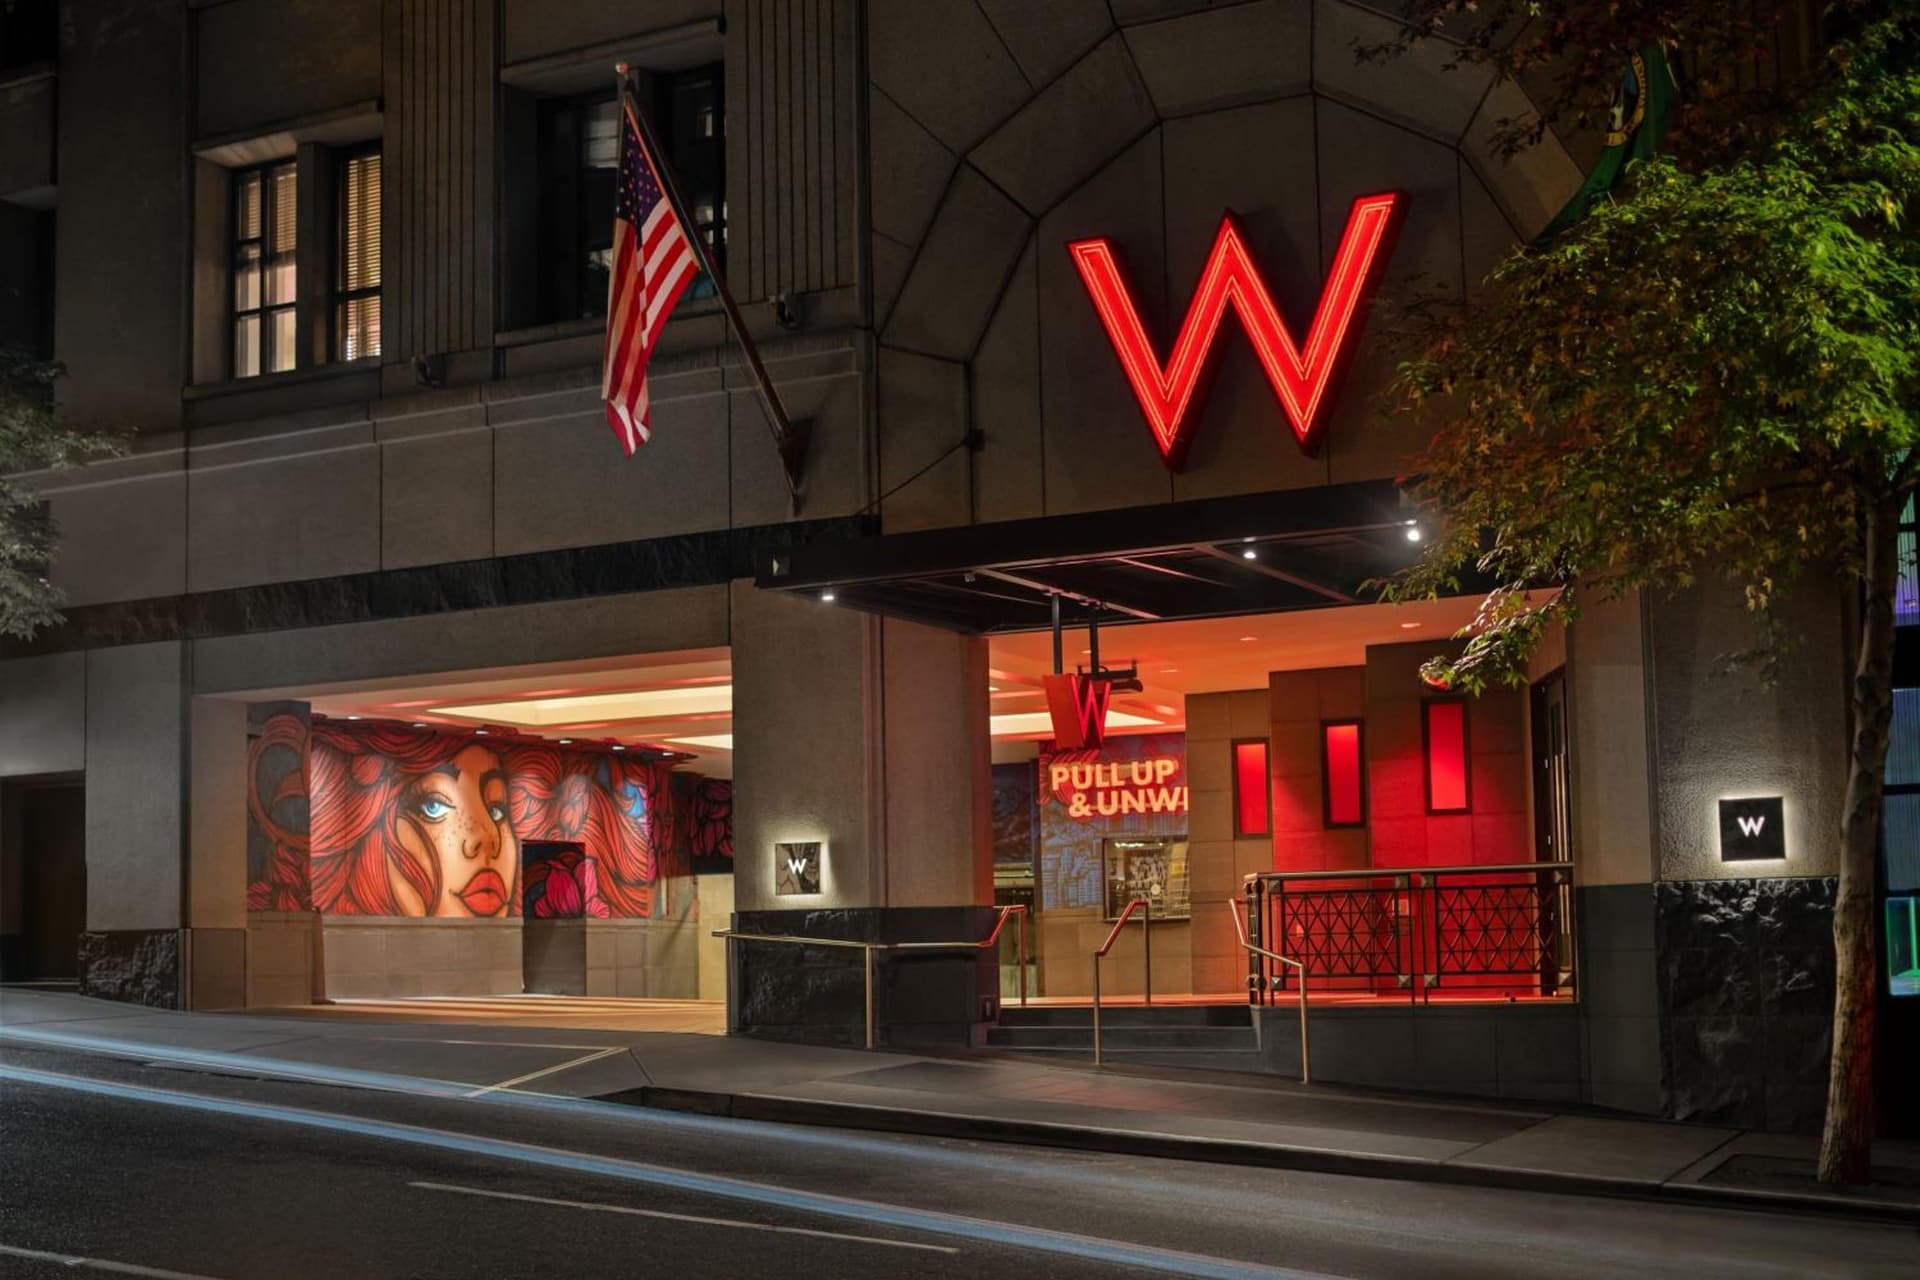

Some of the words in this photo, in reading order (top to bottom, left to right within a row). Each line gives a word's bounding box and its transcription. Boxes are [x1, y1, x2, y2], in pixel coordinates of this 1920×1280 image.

[1068, 191, 1402, 462] W
[1067, 674, 1111, 745] W
[1052, 763, 1125, 791] PULL
[1131, 759, 1174, 786] UP
[1069, 793, 1093, 818] &
[1737, 815, 1765, 837] W
[787, 858, 807, 875] W
